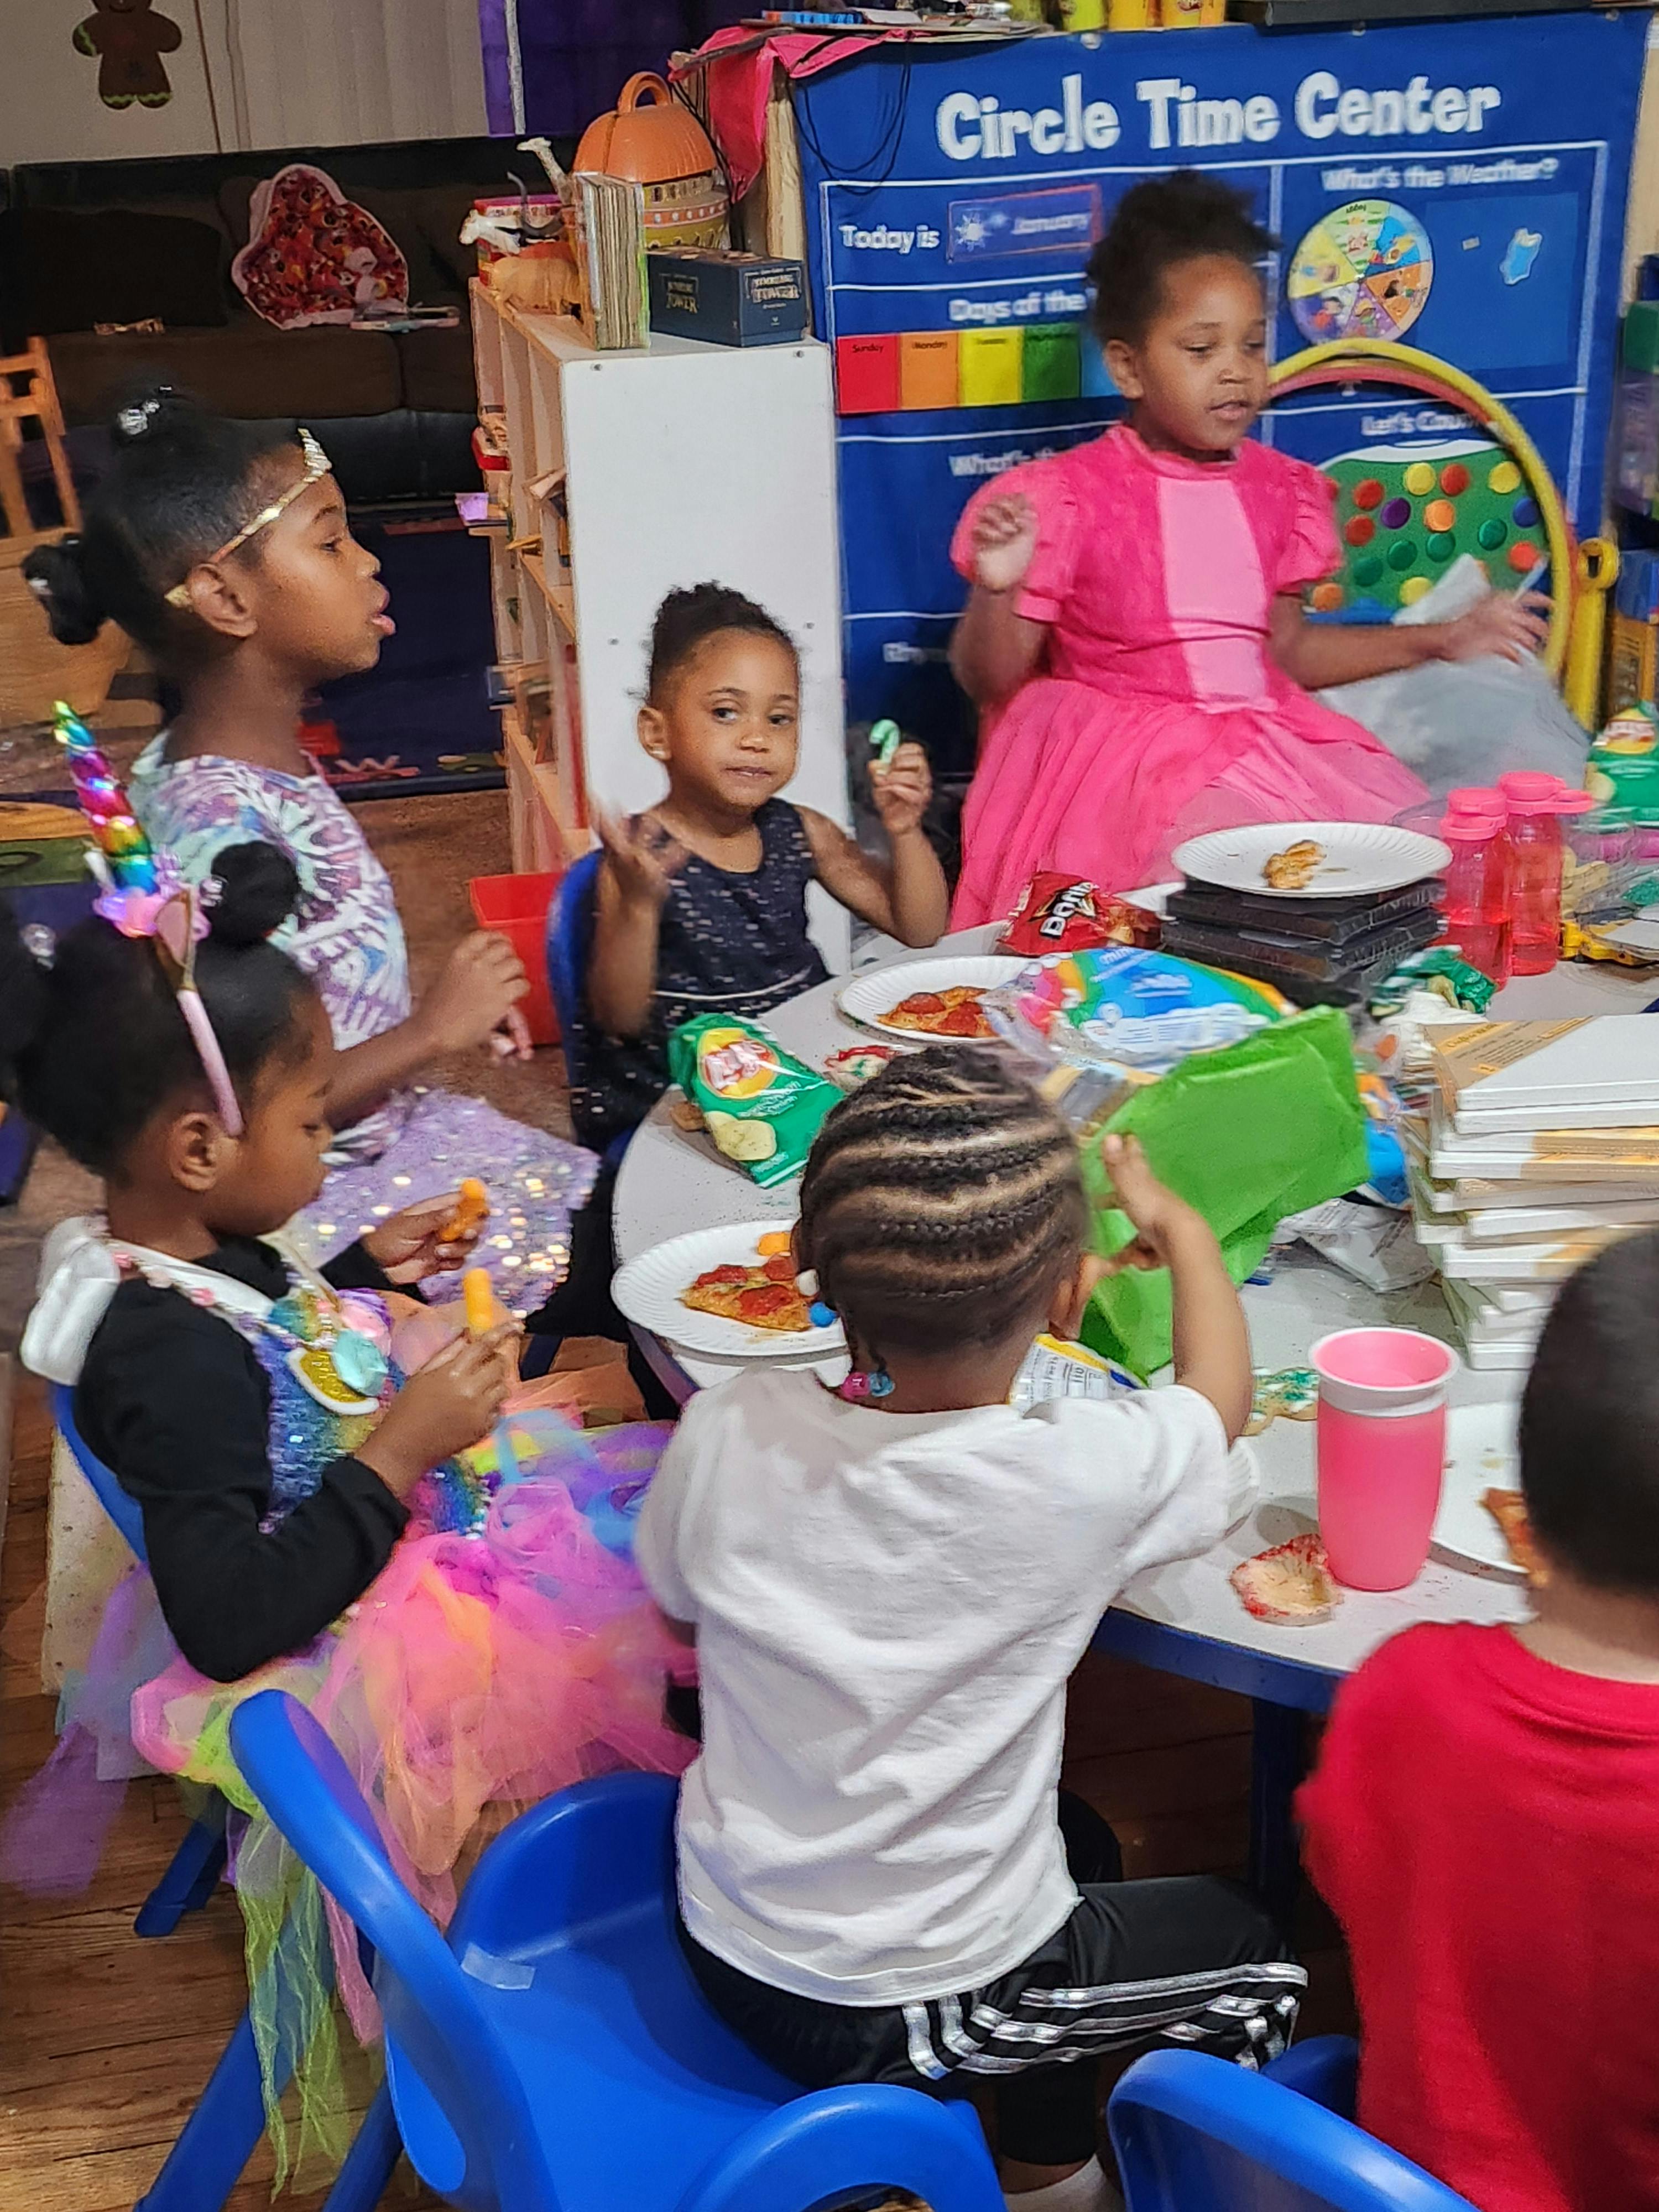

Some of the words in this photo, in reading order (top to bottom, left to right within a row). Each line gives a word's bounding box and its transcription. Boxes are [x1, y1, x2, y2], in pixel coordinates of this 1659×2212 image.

[936, 72, 1121, 160] Circle
[1135, 77, 1282, 150] Time
[1294, 71, 1501, 139] Center
[1321, 166, 1401, 191] What's
[1404, 165, 1445, 188] the
[1446, 156, 1559, 186] Weather?
[838, 223, 915, 254] Today
[916, 224, 940, 248] is
[949, 299, 1011, 324] Days
[1013, 291, 1041, 316] of
[1044, 289, 1088, 312] the
[852, 344, 884, 354] Sunday
[913, 340, 948, 350] Monday
[1361, 411, 1416, 436] Let's
